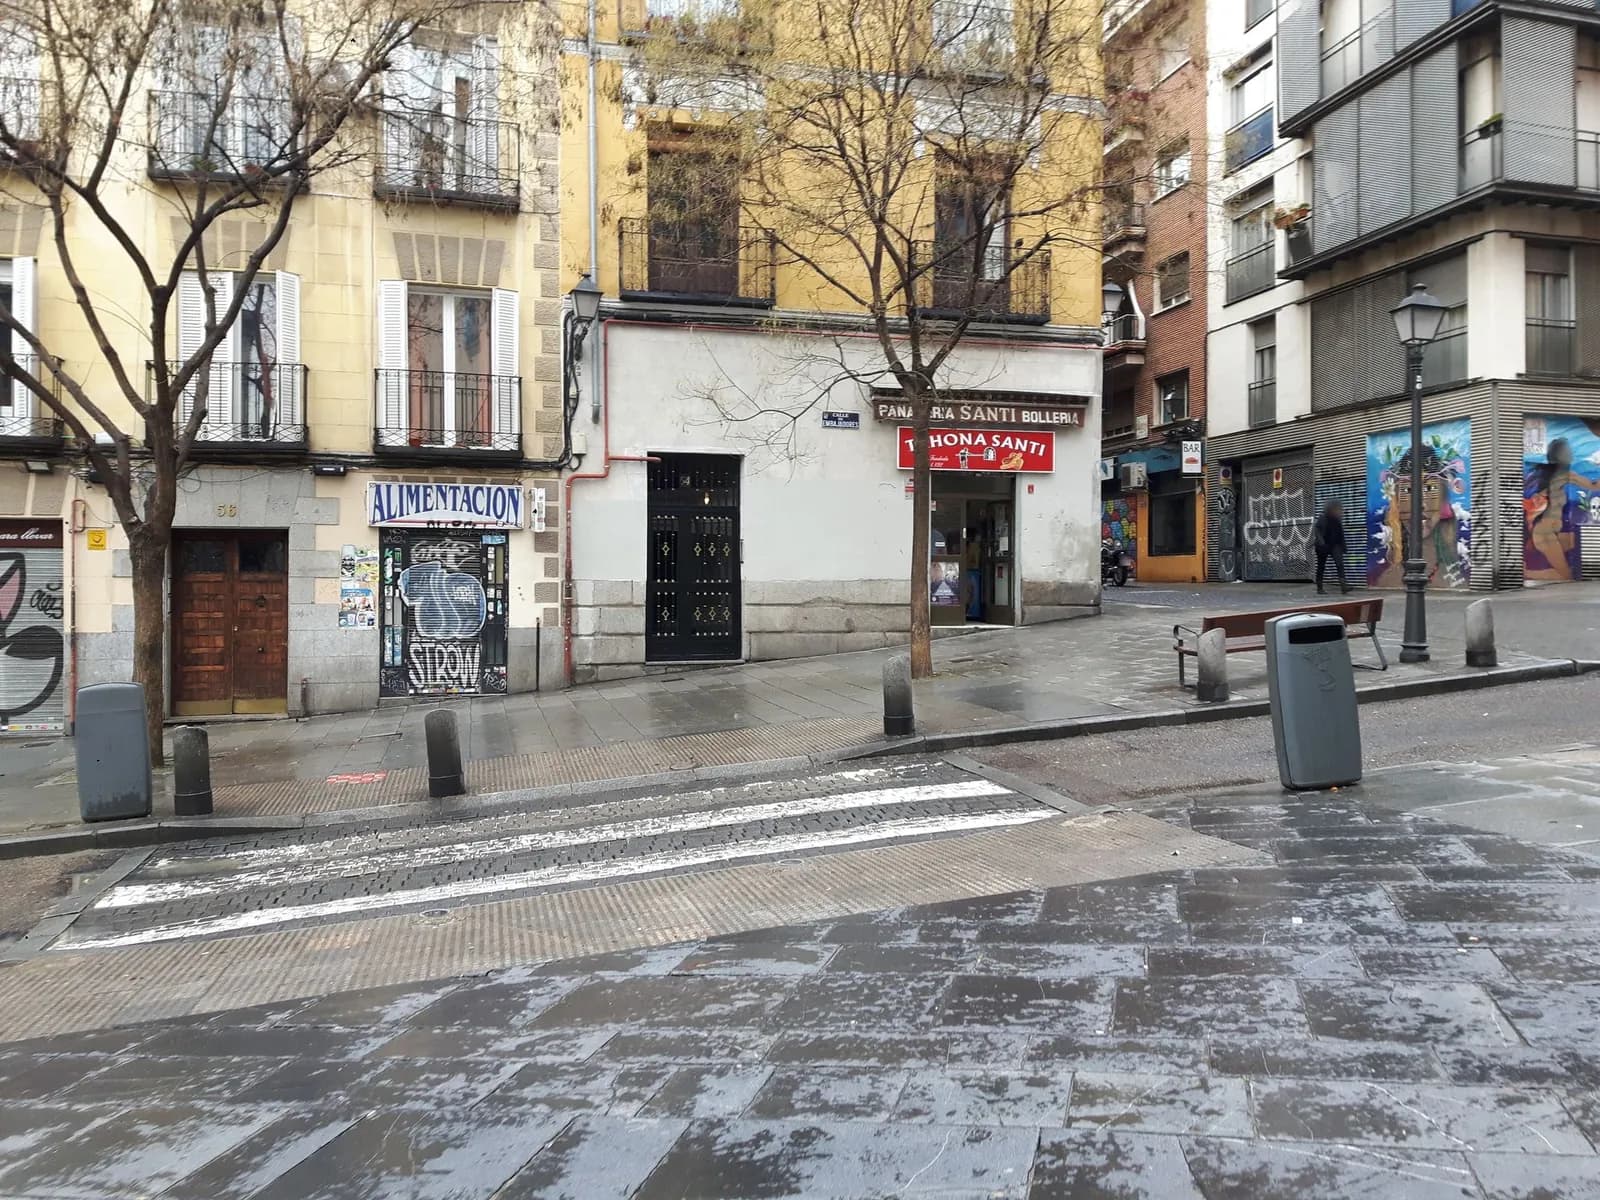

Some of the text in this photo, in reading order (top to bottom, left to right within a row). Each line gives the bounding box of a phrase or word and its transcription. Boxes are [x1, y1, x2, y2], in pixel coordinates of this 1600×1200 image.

[879, 404, 1080, 425] PANARIA SANTI BOLLERIA
[904, 432, 1046, 457] THONA SANTI
[1183, 443, 1200, 454] BAR
[372, 483, 521, 527] ALIMENTACION
